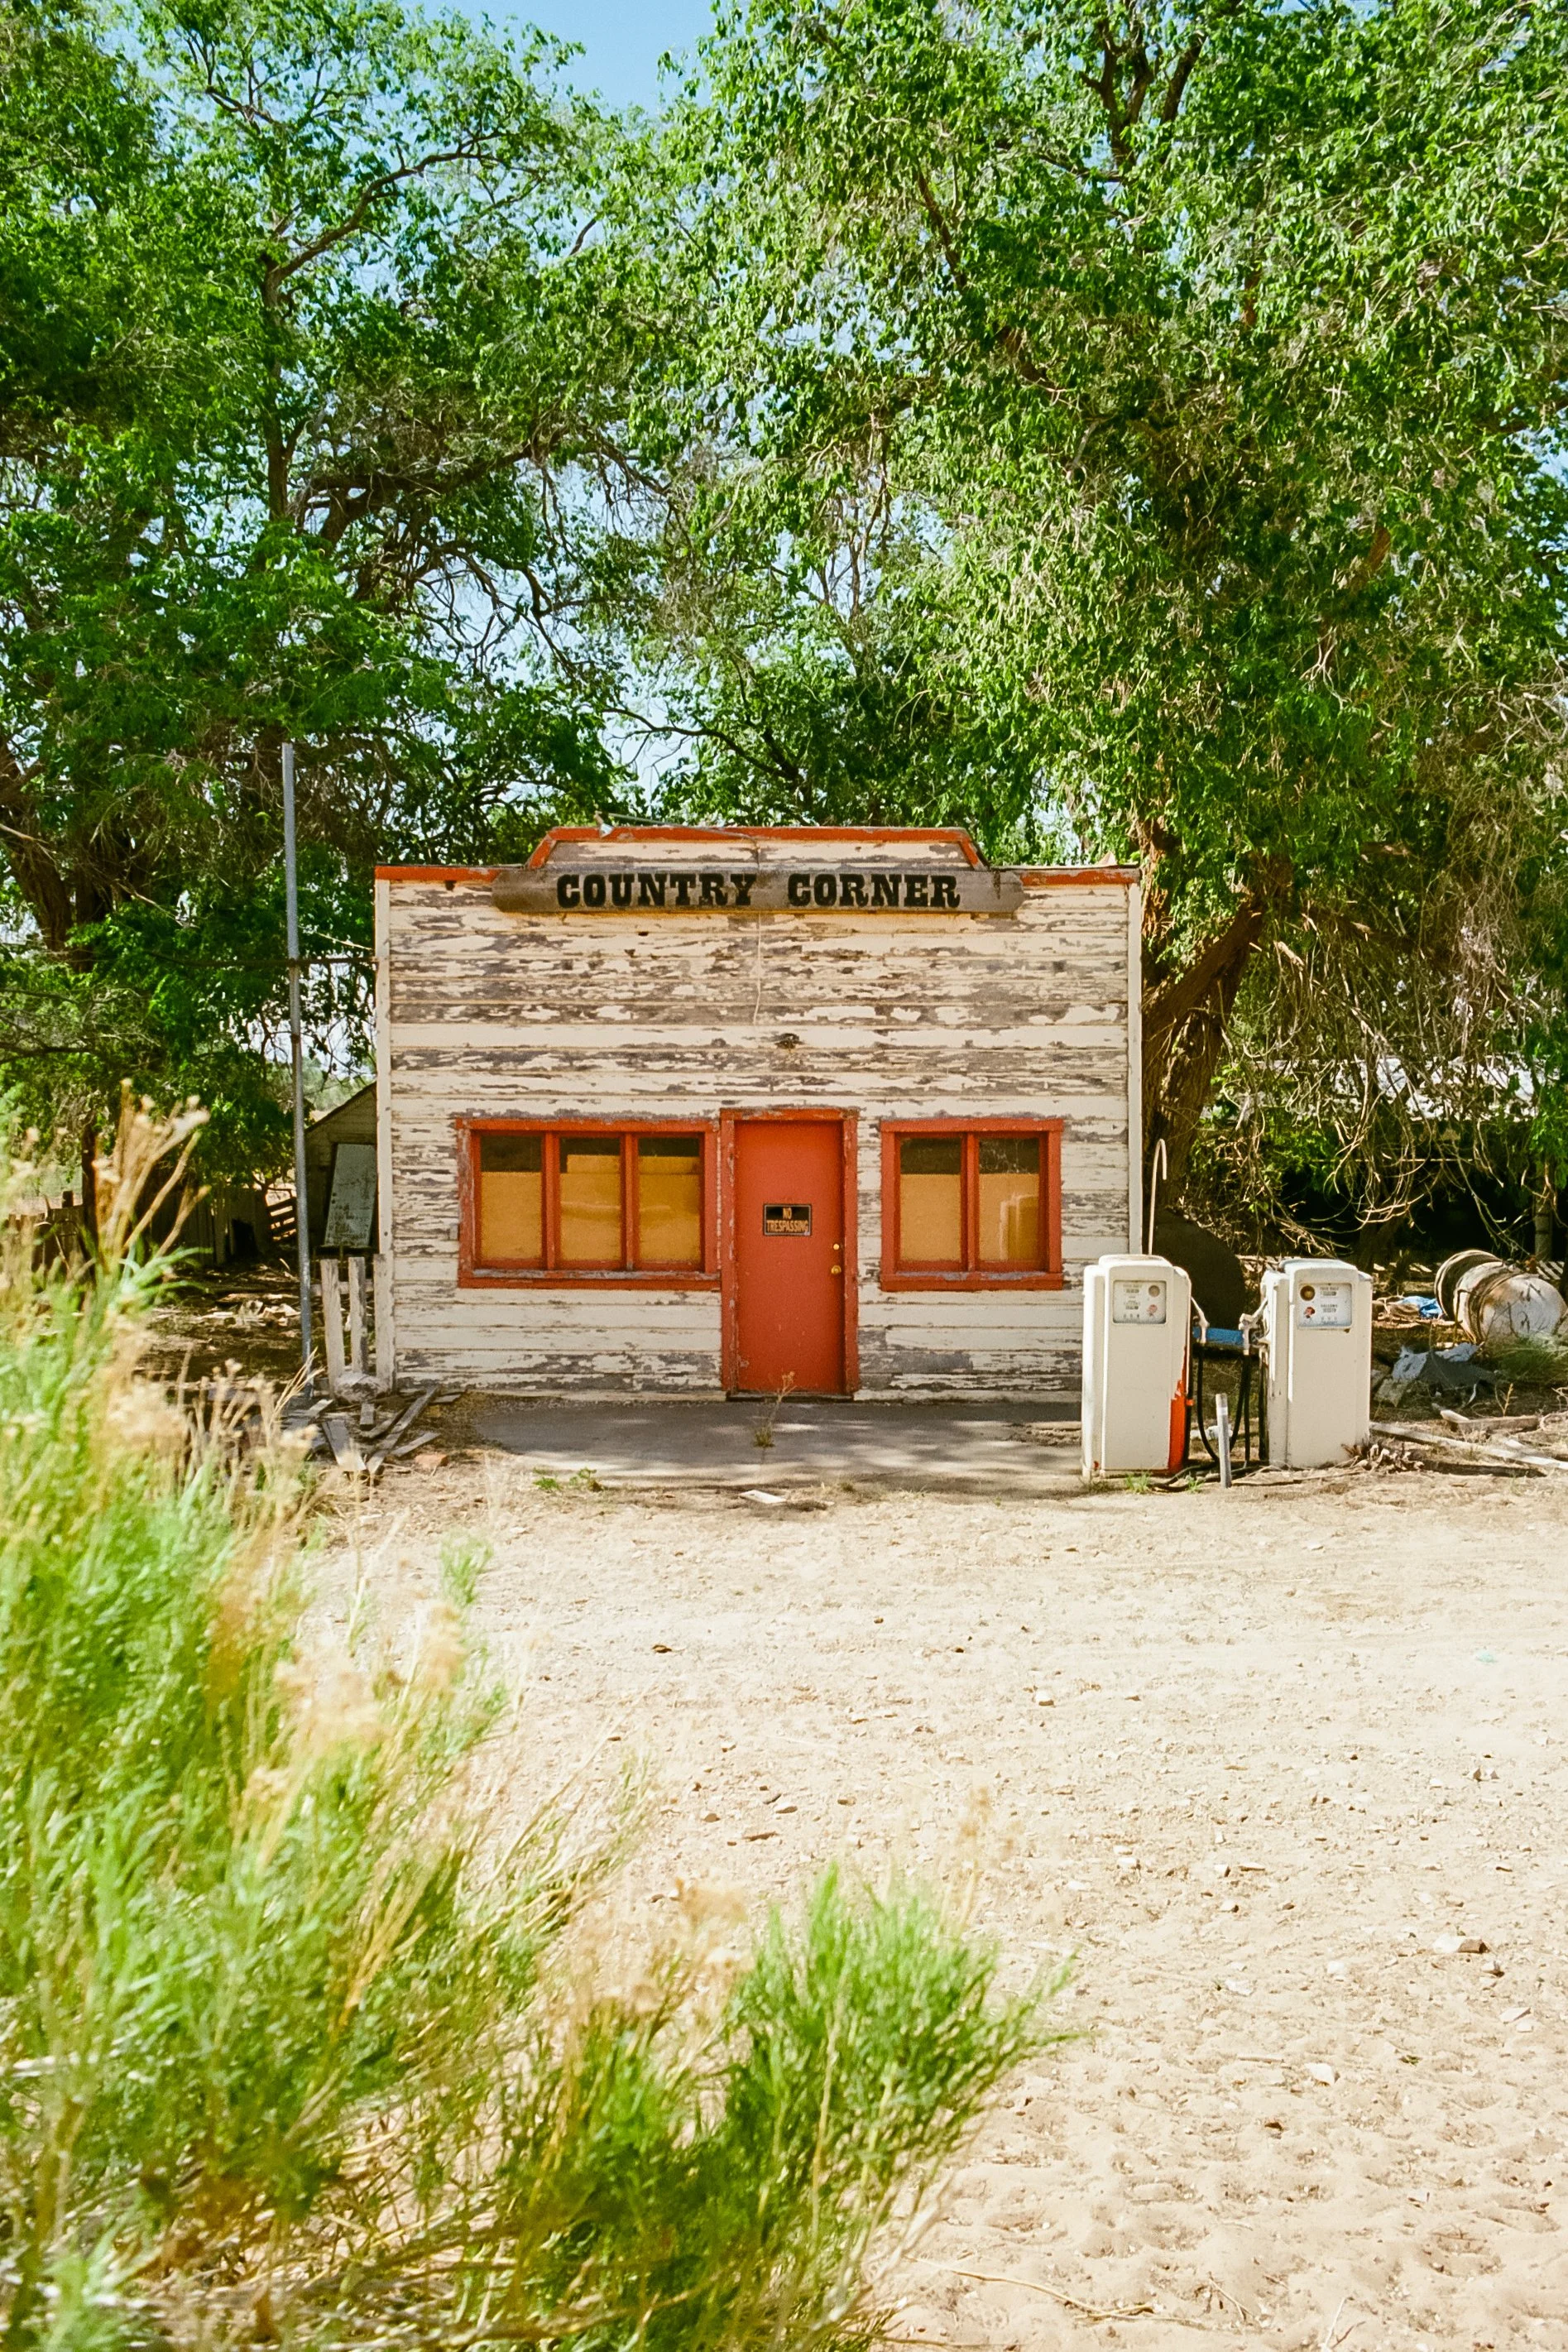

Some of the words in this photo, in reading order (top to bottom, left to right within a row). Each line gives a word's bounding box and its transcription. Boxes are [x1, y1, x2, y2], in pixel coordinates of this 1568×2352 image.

[557, 873, 757, 908] COUNTRY
[787, 873, 961, 908] CORNER
[783, 1207, 792, 1219] NO
[766, 1220, 808, 1232] TRESPASSING
